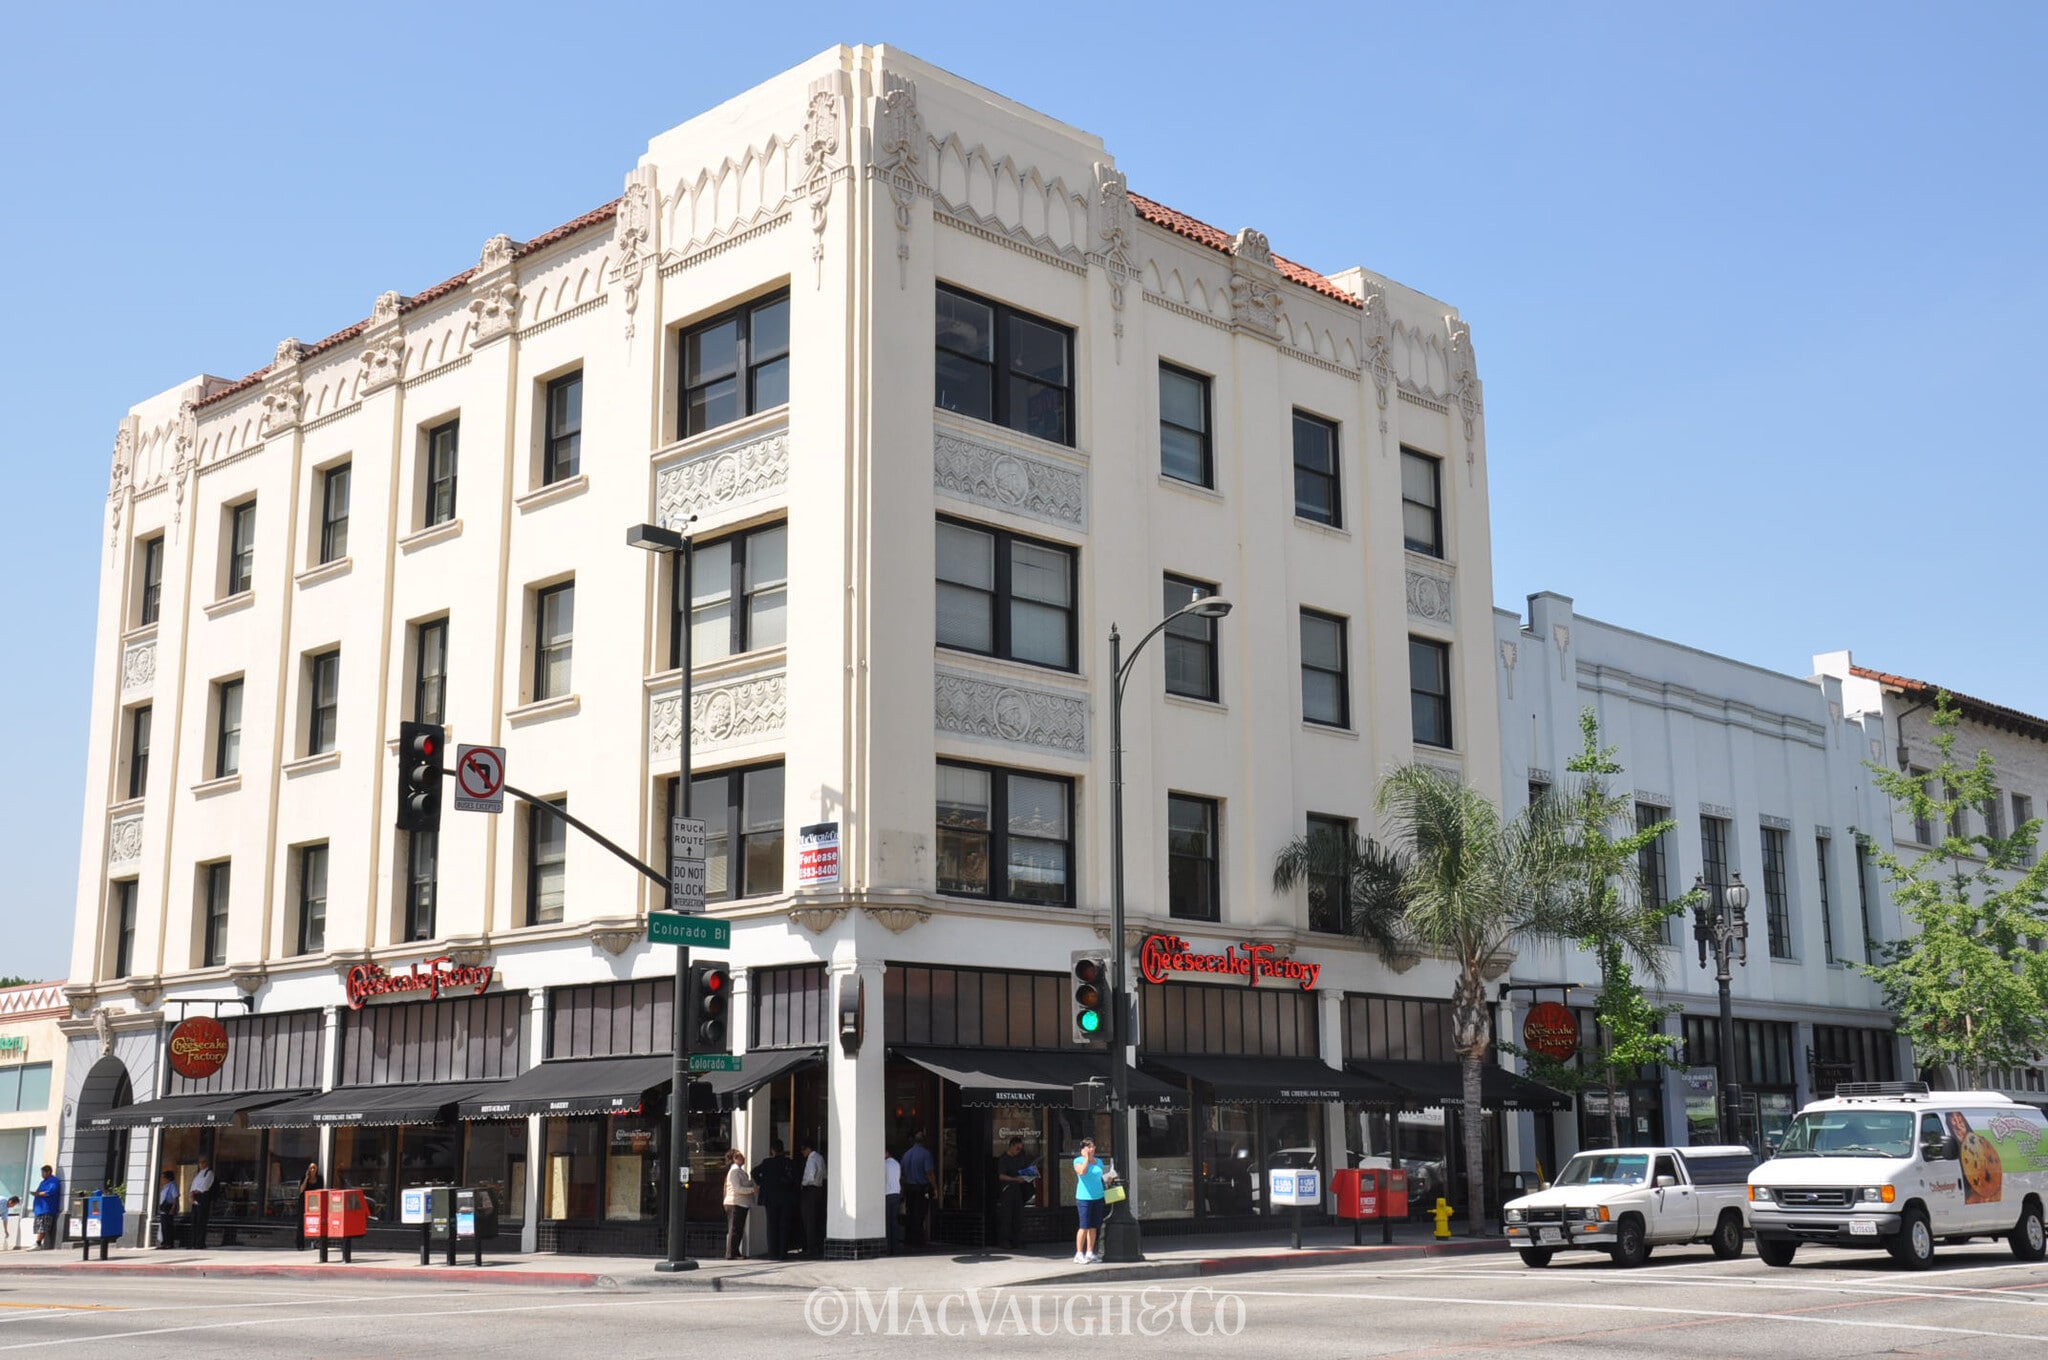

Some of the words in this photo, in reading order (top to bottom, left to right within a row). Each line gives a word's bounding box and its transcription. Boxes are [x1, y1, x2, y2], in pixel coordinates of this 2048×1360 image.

[675, 823, 704, 834] TRUCK
[674, 835, 704, 846] ROUTE
[674, 866, 686, 878] DO
[687, 868, 704, 880] NOT
[674, 885, 704, 897] BLOCK
[652, 922, 707, 939] Colorado
[1166, 936, 1190, 951] The
[1141, 934, 1250, 985] Cheesecake
[1242, 942, 1322, 991] Factory
[346, 963, 430, 1010] Cheesecake
[424, 956, 495, 1002] Factory
[171, 1036, 228, 1055] Cheesecake
[183, 1048, 227, 1066] Factory
[689, 1056, 726, 1069] Colorado
[995, 1092, 1036, 1100] RESTAURANT
[1159, 1095, 1172, 1103] BAR
[481, 1104, 511, 1113] RESTAURANT
[612, 1098, 623, 1106] BAR
